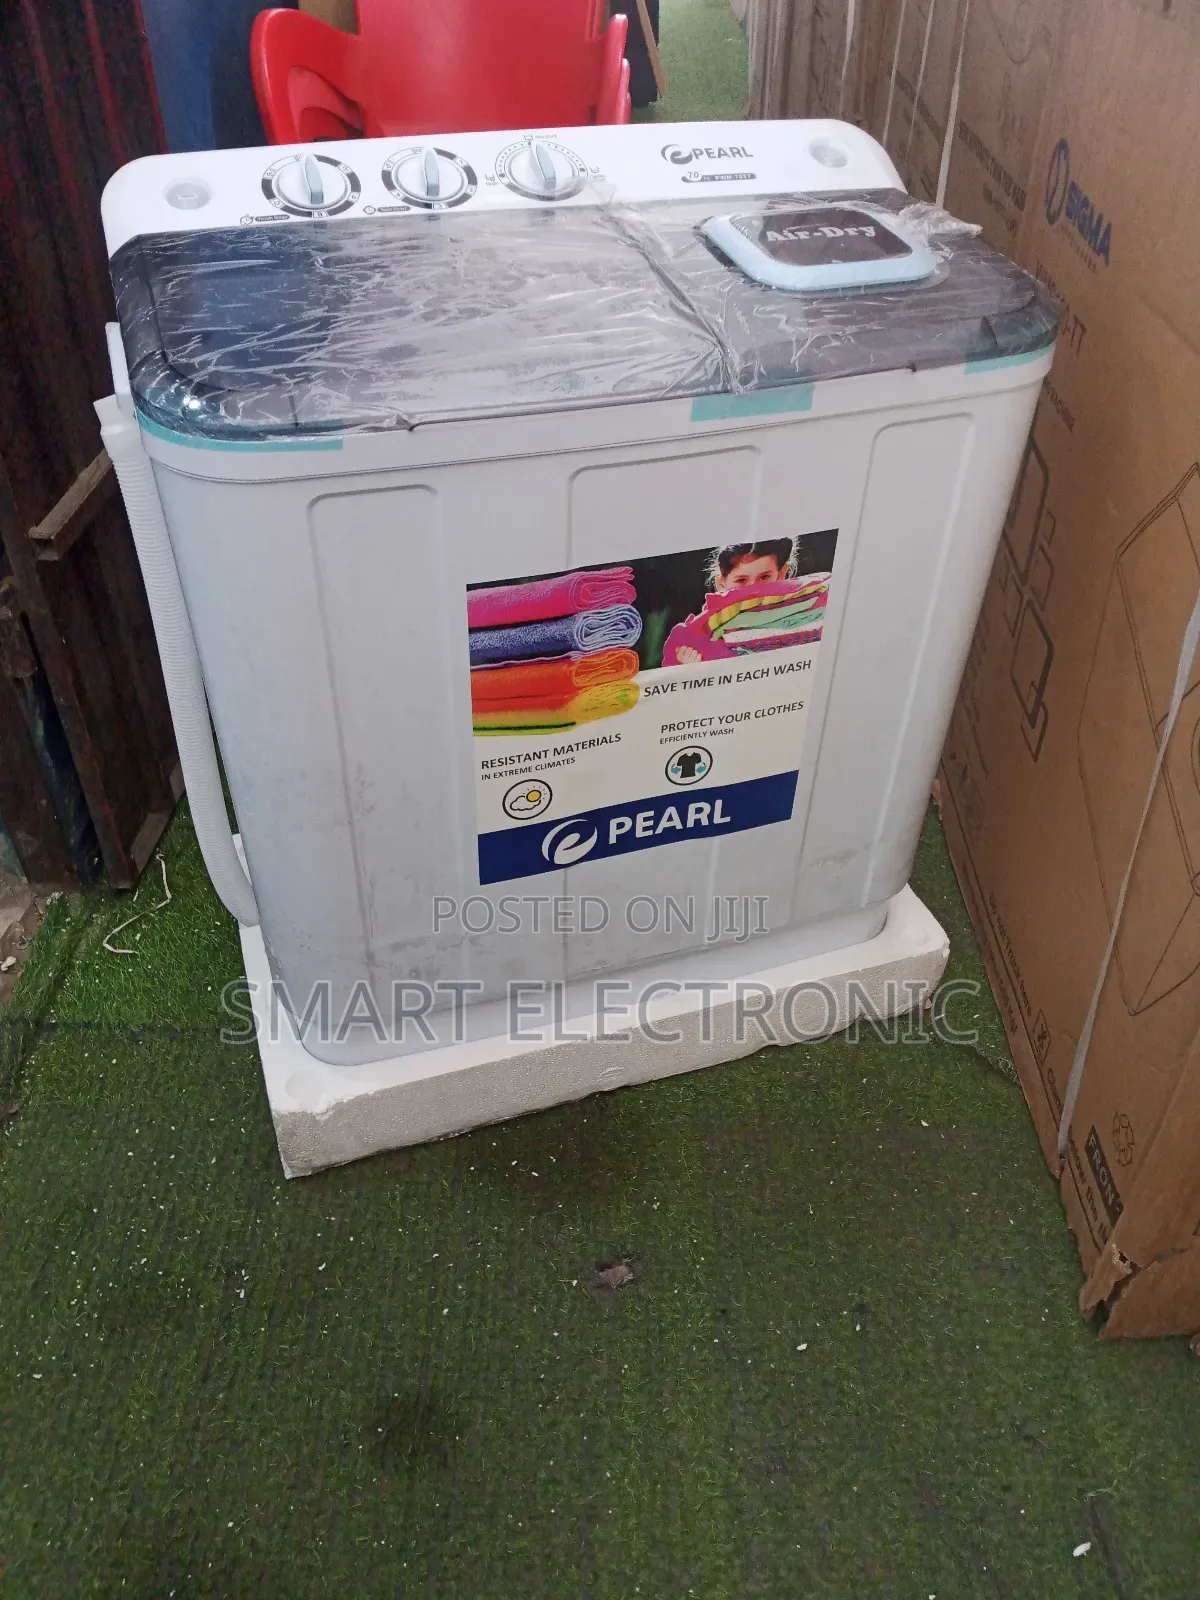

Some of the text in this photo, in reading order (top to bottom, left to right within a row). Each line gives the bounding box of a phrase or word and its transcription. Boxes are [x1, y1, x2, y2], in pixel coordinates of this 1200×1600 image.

[691, 146, 754, 160] PEARL
[687, 171, 700, 179] 7.0
[766, 226, 876, 242] Air-Dry
[643, 659, 812, 698] SAVE TIME IN EACH WASH
[660, 700, 804, 734] PROTECT YOUR CLOTHES
[659, 727, 735, 745] EFFICIENTLY WASH
[481, 733, 622, 770] RESISTANT MATERIALS
[481, 756, 576, 781] IN EXTREME CLIMATES
[608, 799, 731, 845] PEARL
